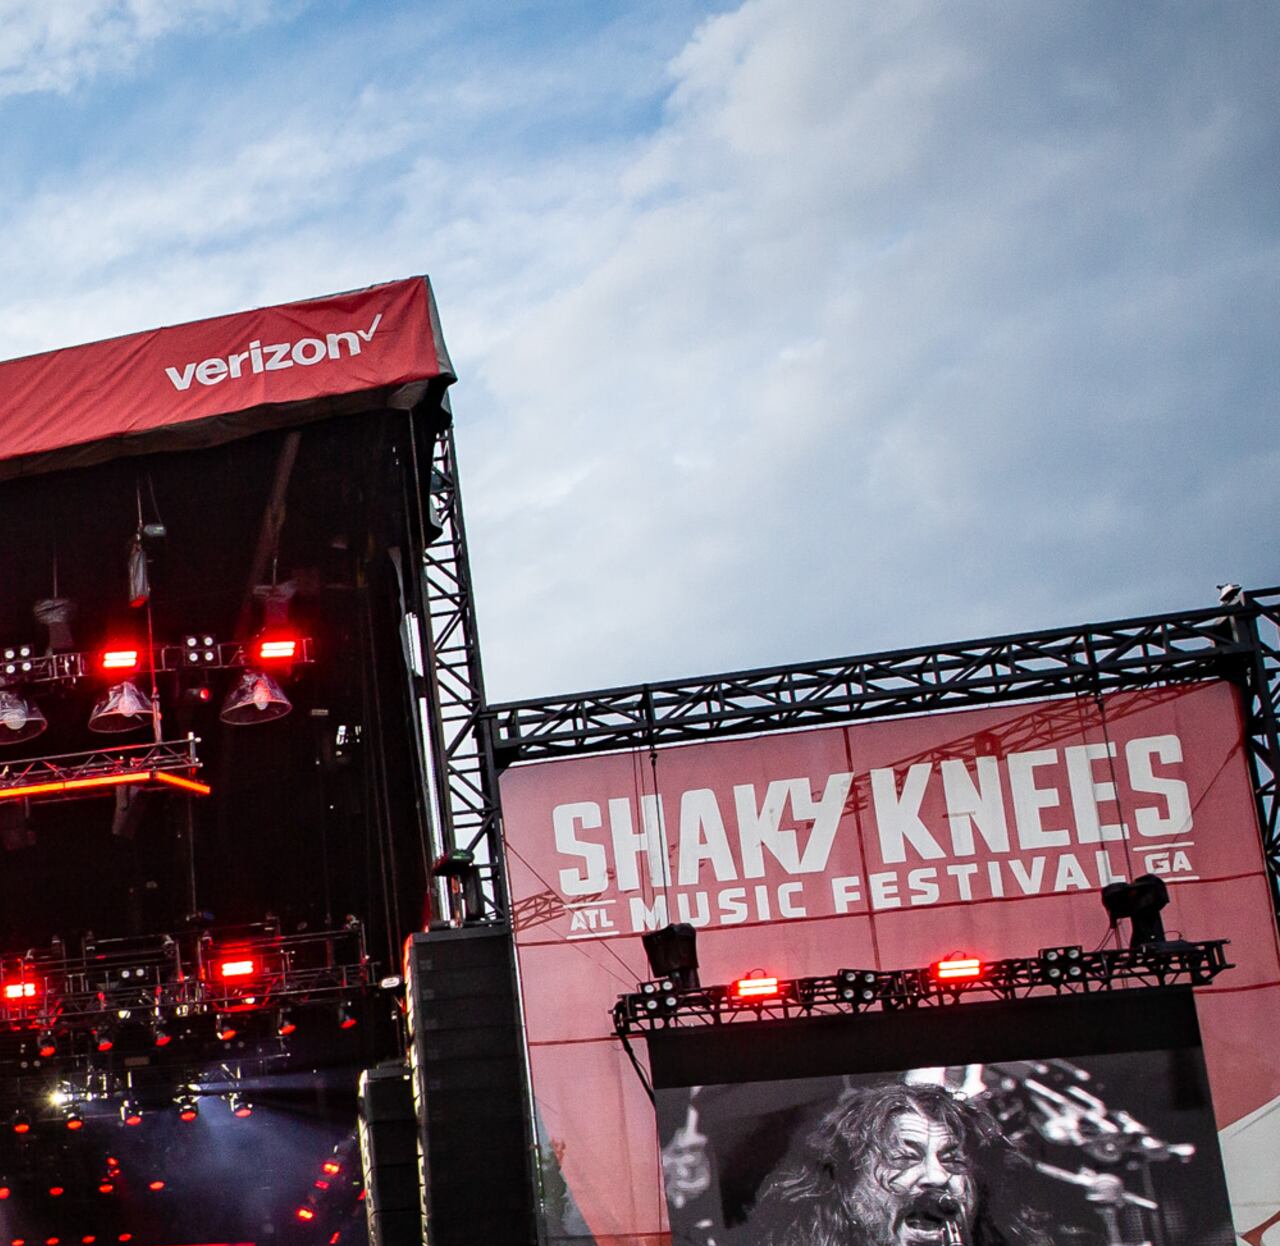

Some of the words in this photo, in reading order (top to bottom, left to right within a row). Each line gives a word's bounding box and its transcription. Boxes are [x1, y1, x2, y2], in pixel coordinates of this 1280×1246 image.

[164, 329, 361, 391] verizon
[552, 772, 853, 897] SHAKY
[870, 734, 1194, 863] KNEES
[569, 908, 615, 931] ATL
[629, 879, 807, 933] MUSIC
[833, 850, 1126, 911] FESTIVAL
[1144, 850, 1193, 874] GA
